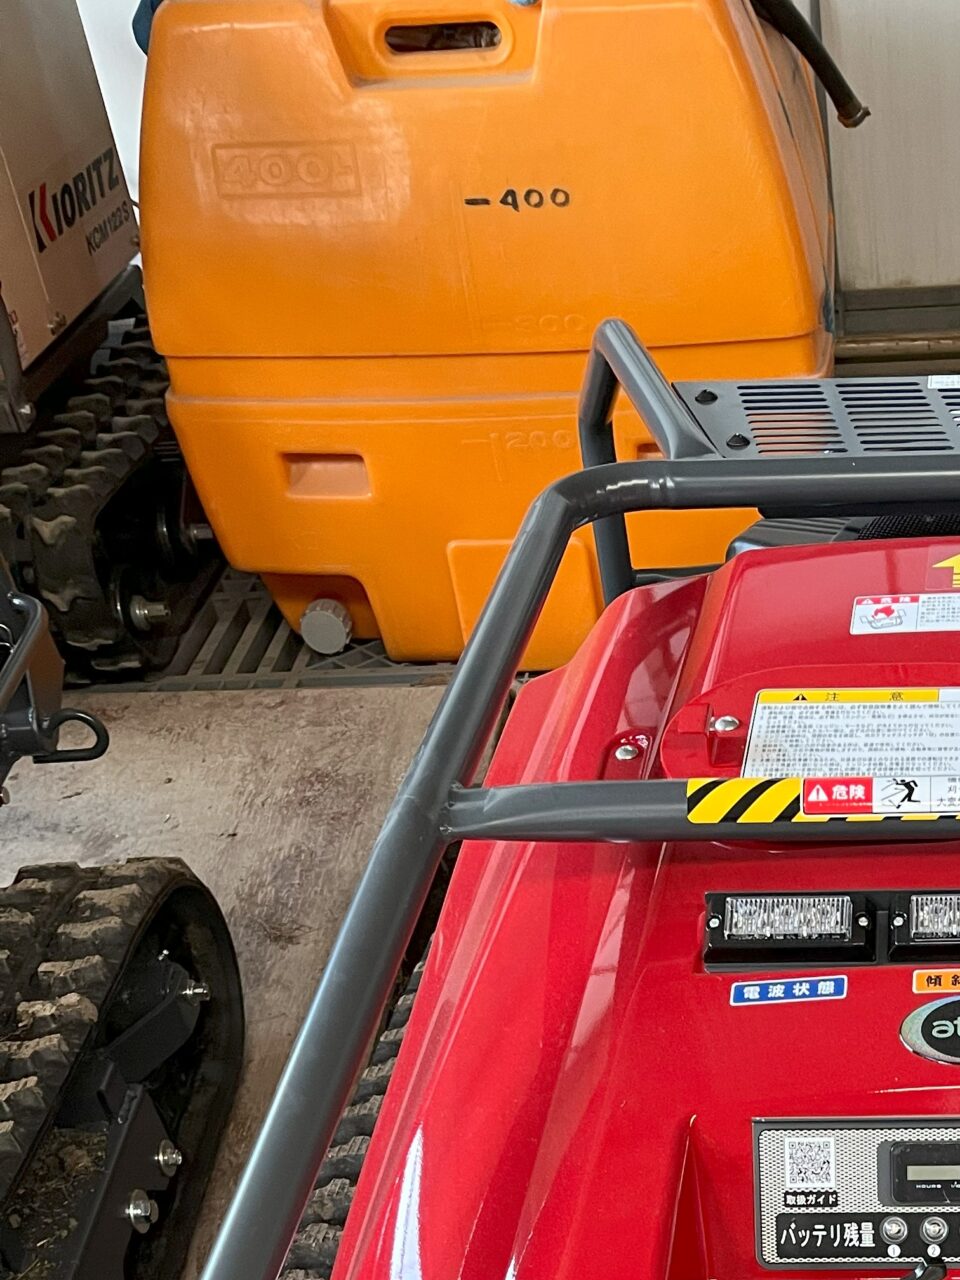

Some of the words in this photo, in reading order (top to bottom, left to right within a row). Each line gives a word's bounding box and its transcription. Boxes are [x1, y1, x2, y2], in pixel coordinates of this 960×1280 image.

[28, 147, 119, 253] KIORITZ
[825, 692, 904, 702] 注意
[832, 785, 865, 800] 危険
[743, 980, 835, 1000] 電波状態
[785, 1191, 837, 1205] 取扱ガイド
[780, 1219, 876, 1248] バッテリ残量
